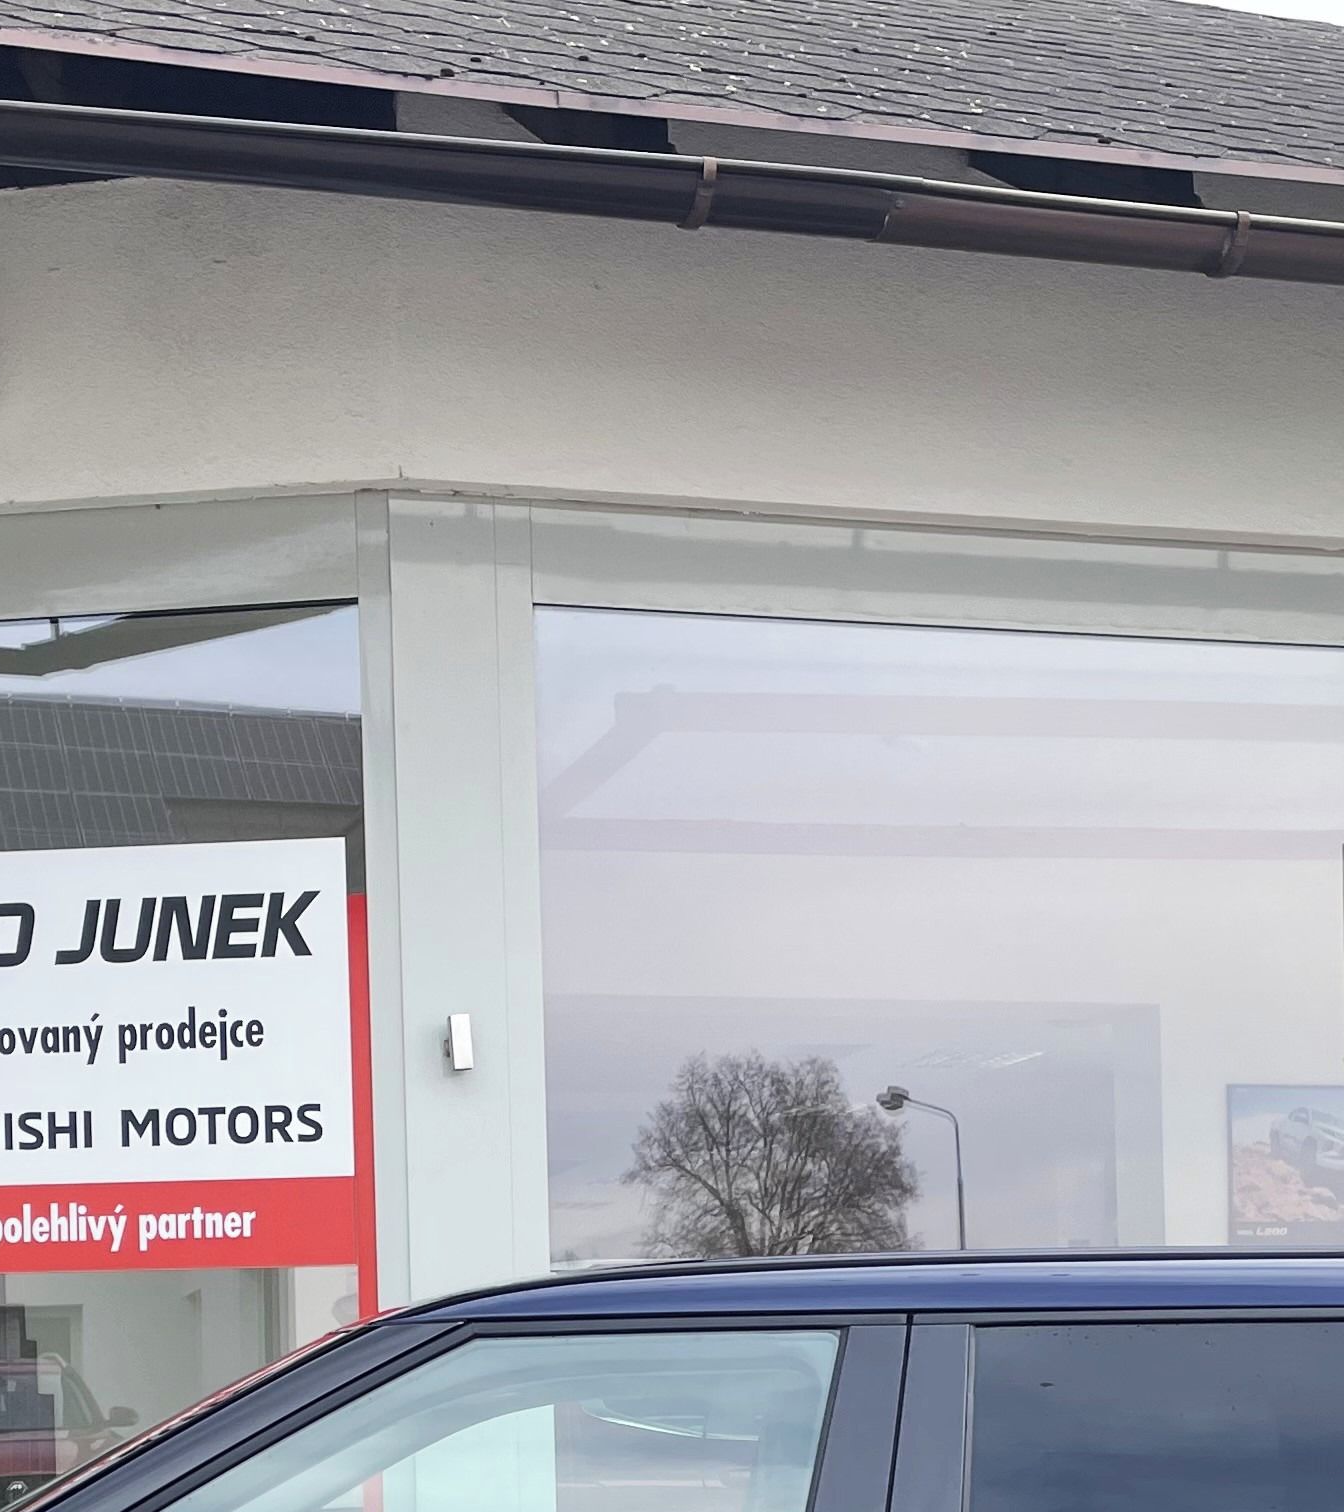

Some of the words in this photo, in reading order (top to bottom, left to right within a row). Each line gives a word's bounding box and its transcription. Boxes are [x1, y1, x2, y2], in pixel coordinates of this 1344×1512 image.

[54, 890, 321, 966] JUNEK
[118, 1005, 264, 1063] prodejce
[120, 1103, 323, 1148] MOTORS
[138, 1205, 257, 1252] partner
